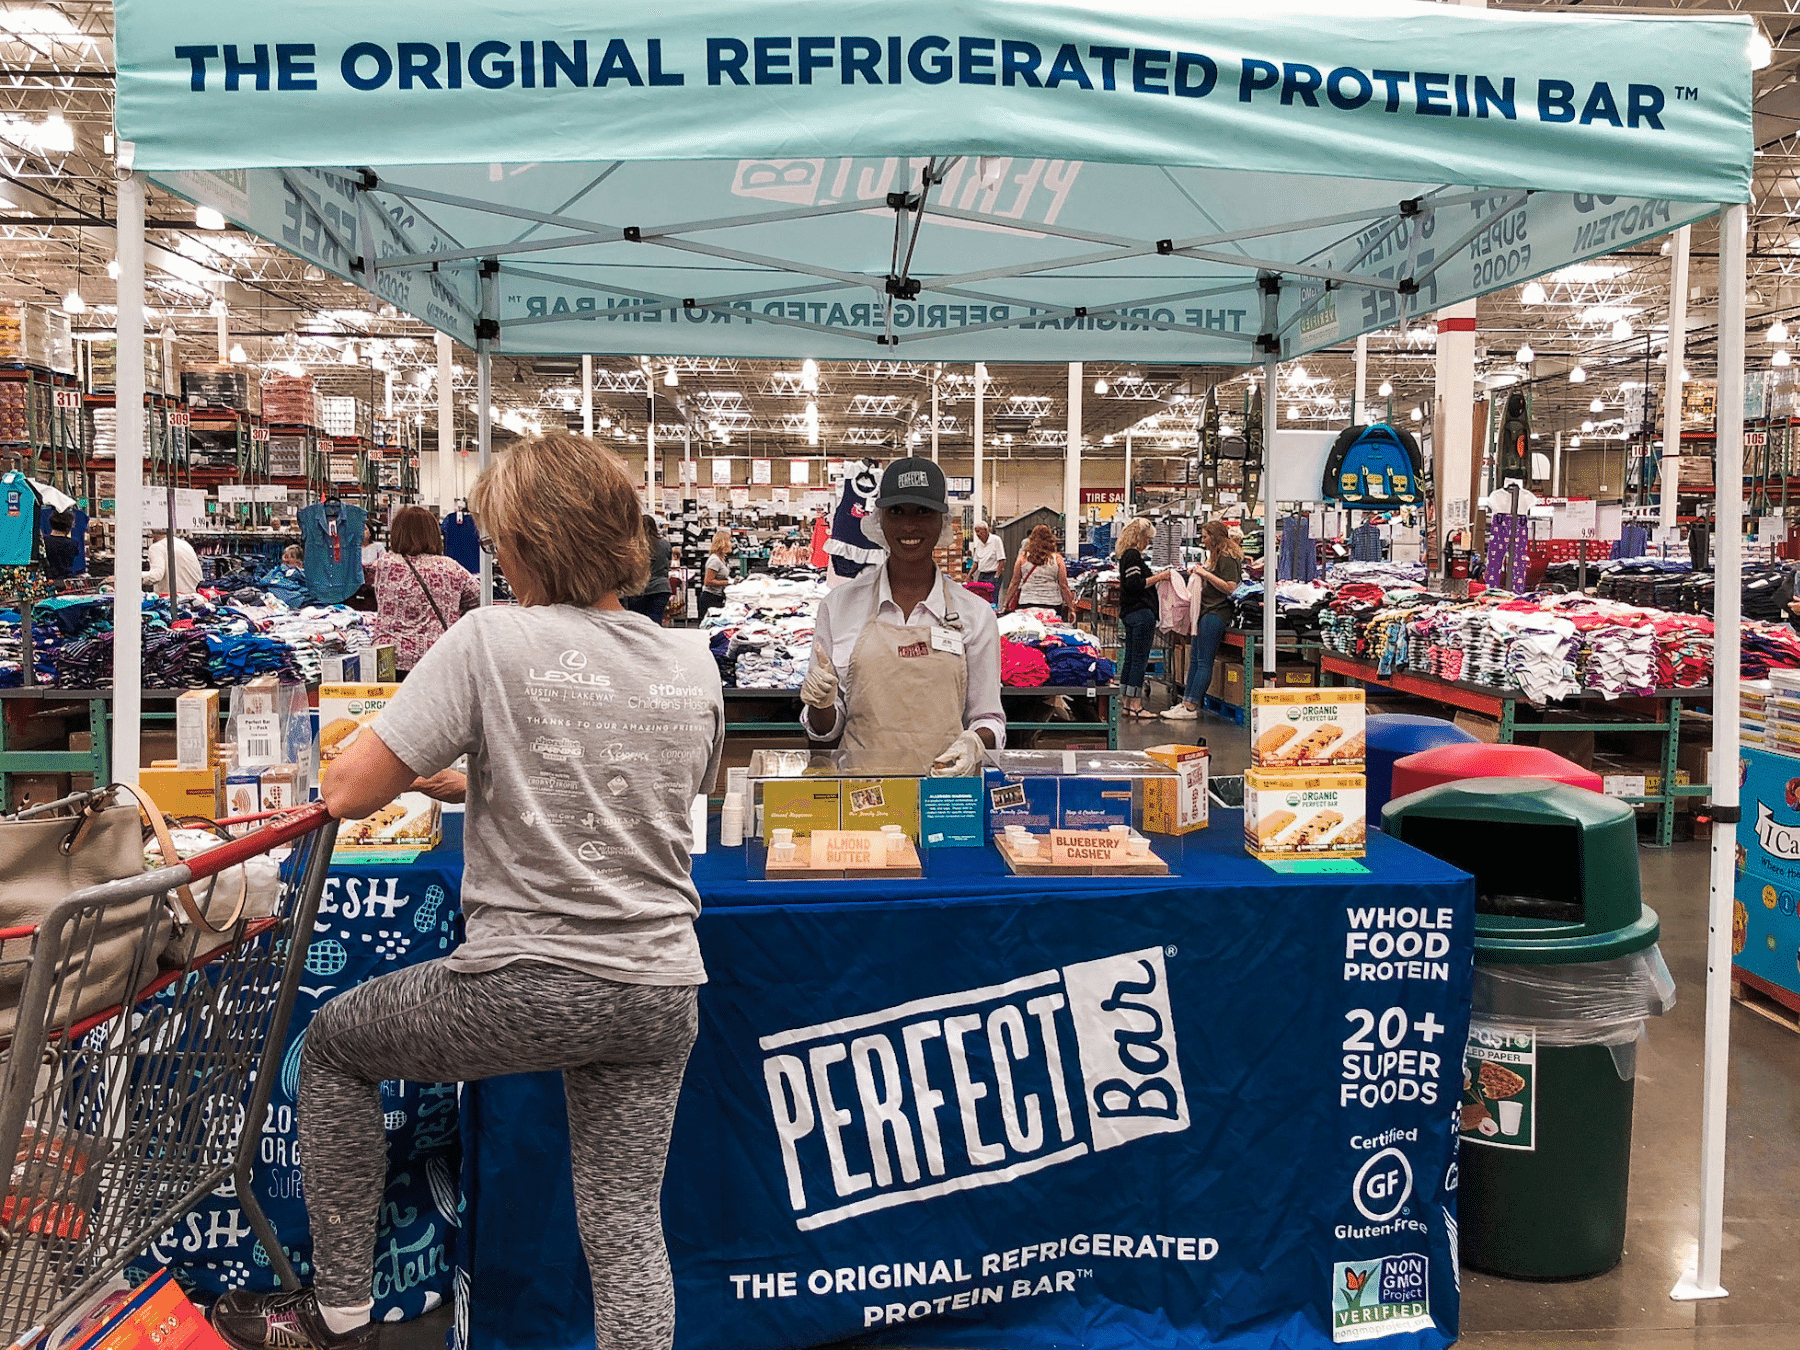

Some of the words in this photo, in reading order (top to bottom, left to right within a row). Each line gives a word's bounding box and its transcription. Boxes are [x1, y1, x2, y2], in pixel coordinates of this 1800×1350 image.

[175, 43, 317, 91] THE
[341, 38, 685, 90] ORIGINAL
[706, 35, 1218, 98] REFRIGERATED
[1239, 57, 1516, 120] PROTEIN
[57, 392, 79, 407] 311
[170, 414, 188, 426] 309
[253, 429, 269, 441] 307
[1746, 433, 1765, 445] 105
[318, 441, 333, 452] 305
[369, 451, 383, 460] 303
[1086, 492, 1107, 503] TIRE
[192, 516, 206, 528] 9.99
[1582, 528, 1595, 538] 9.99
[529, 668, 611, 686] LEXUS
[524, 687, 558, 697] AUSTIN
[571, 691, 615, 701] LAKEWAY
[1302, 706, 1338, 715] ORGANIC
[527, 716, 571, 727] THANKS
[577, 720, 591, 729] TO
[596, 722, 618, 730] OUR
[622, 723, 669, 731] AMAZING
[1302, 792, 1338, 801] ORGANIC
[1056, 836, 1120, 849] BLUEBERRY
[1764, 824, 1773, 847] I
[827, 838, 871, 850] ALMOND
[826, 851, 871, 863] BUTTER
[1067, 848, 1111, 860] CASHEW
[1761, 856, 1784, 875] Where
[317, 877, 409, 921] ESH
[1346, 907, 1453, 929] WHOLE
[1345, 931, 1450, 959] FOOD
[1343, 960, 1449, 981] PROTEIN
[1342, 1006, 1445, 1051] 20+
[1487, 1050, 1521, 1062] PAPER
[1341, 1049, 1441, 1080] SUPER
[763, 992, 1065, 1211] PERFECT
[1093, 958, 1181, 1121] Bar
[1340, 1078, 1438, 1108] FOODS
[1350, 1127, 1418, 1150] Certified
[1366, 1169, 1399, 1199] GF
[151, 1208, 252, 1264] ESH
[730, 1272, 798, 1299] THE
[807, 1258, 972, 1295] ORIGINAL
[982, 1233, 1219, 1277] REFRIGERATED
[1385, 1259, 1422, 1275] NON
[1383, 1273, 1423, 1289] GMO
[1382, 1286, 1423, 1302] Project
[863, 1285, 1004, 1328] PROTEIN
[1339, 1302, 1424, 1325] VERIFIED
